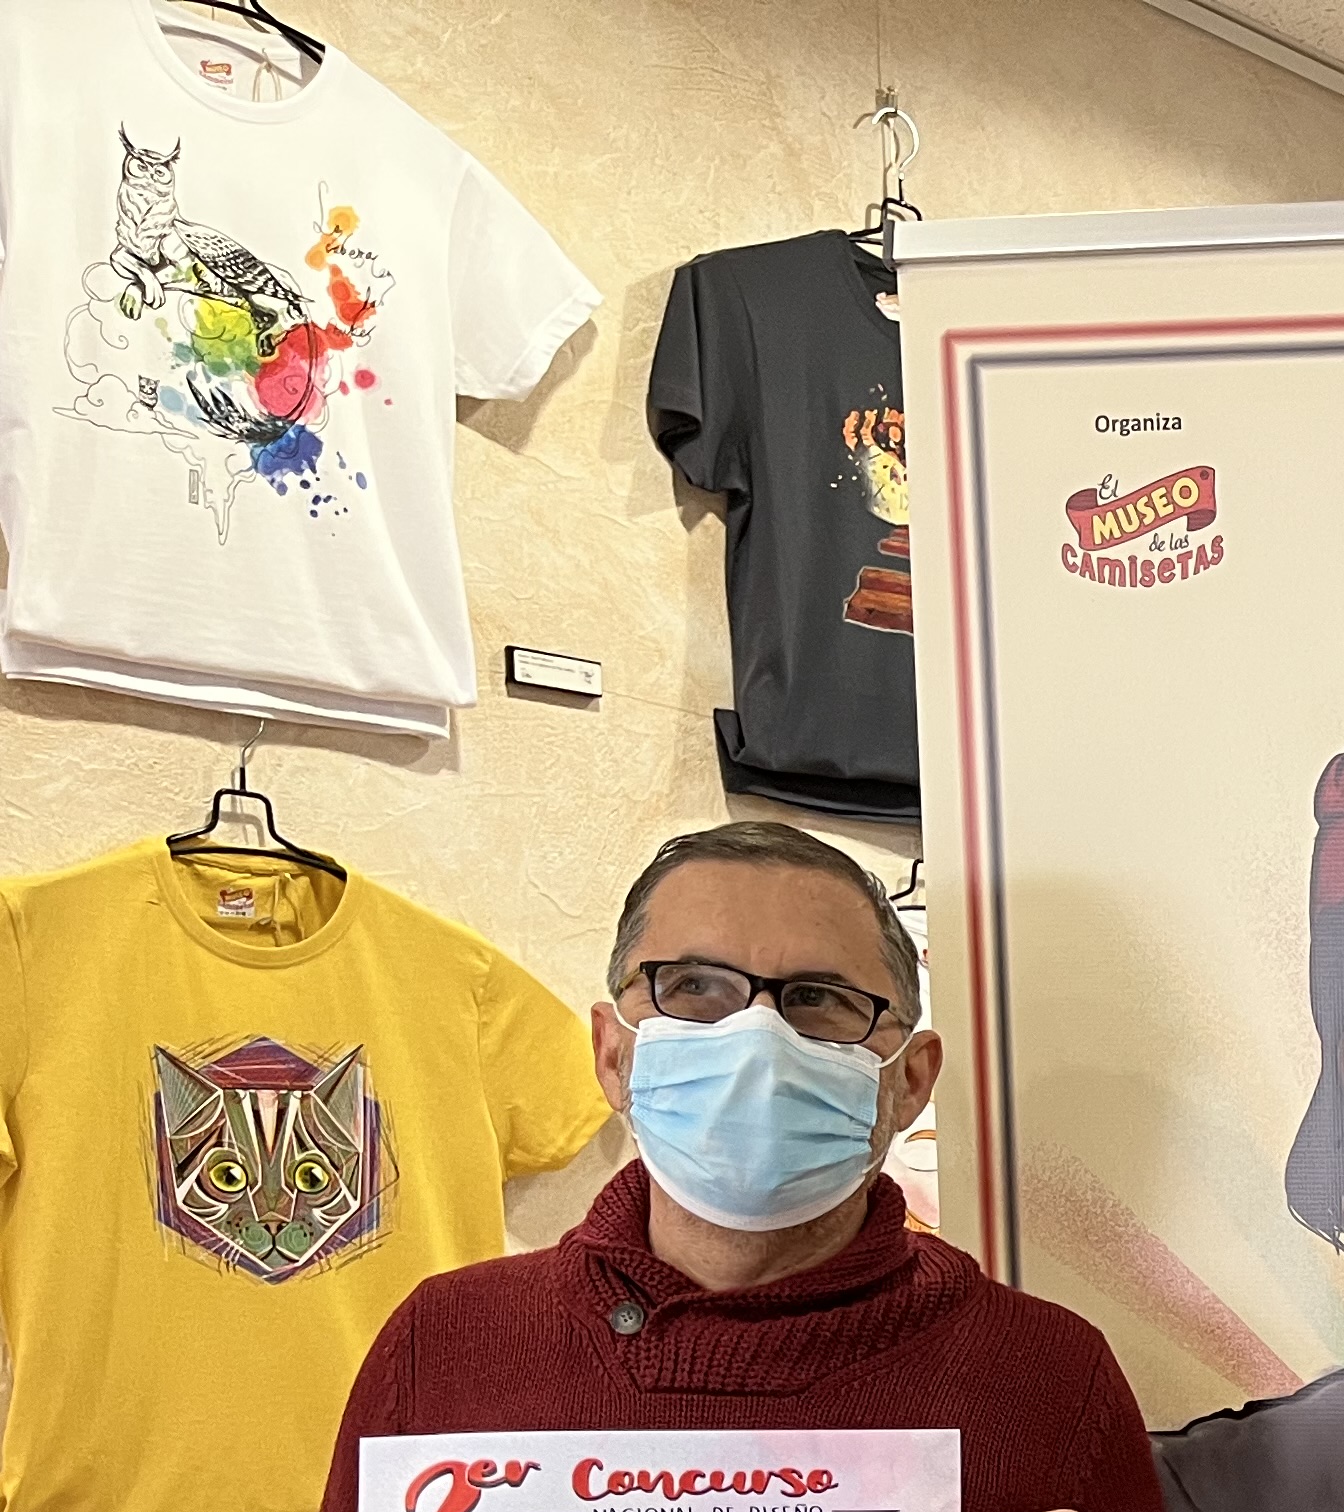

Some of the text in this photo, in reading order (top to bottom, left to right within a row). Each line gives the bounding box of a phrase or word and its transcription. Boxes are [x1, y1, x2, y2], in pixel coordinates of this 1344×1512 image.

[1095, 413, 1182, 437] Organiza
[1098, 473, 1119, 500] El
[1092, 476, 1199, 546] MUSEO
[1149, 533, 1189, 552] de las
[572, 1457, 839, 1500] Concurso
